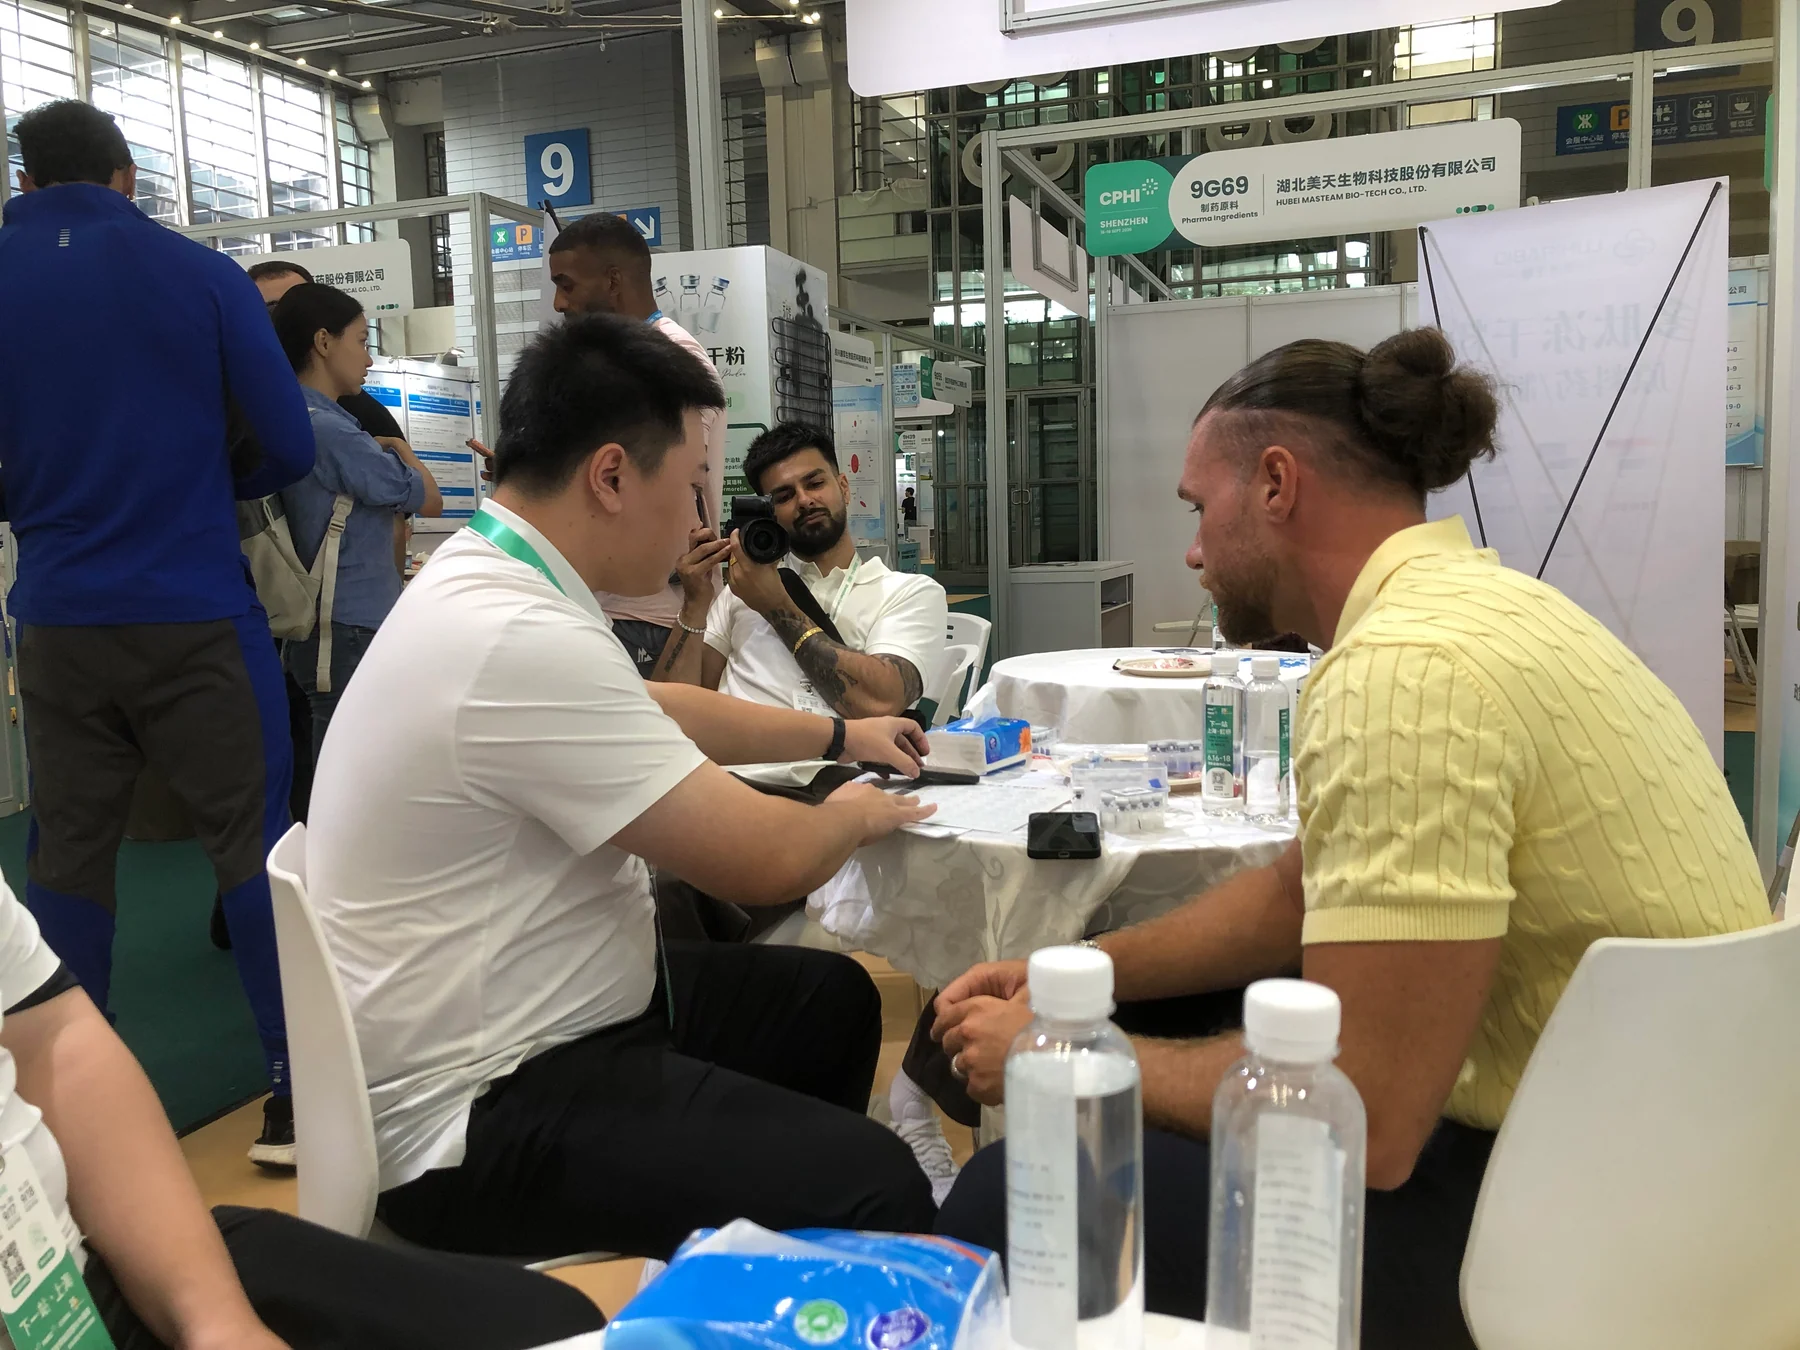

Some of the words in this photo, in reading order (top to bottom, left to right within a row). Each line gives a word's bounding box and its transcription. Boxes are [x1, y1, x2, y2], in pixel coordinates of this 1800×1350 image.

[1660, 0, 1714, 45] 9
[540, 142, 575, 197] 9
[1276, 156, 1496, 194] 湖北美天生物科技股份有限公司
[1190, 175, 1249, 199] 9G69
[1276, 197, 1301, 206] HUBEI
[1301, 193, 1344, 204] MASTEAM
[1345, 189, 1387, 200] BIO-TECH
[1388, 187, 1407, 196] CO.,
[1408, 185, 1427, 193] LTD.
[1099, 188, 1141, 206] CPHI
[1200, 200, 1239, 213] 制药原料
[1100, 216, 1149, 229] SHENZHEN
[1181, 215, 1213, 224] Pharma
[1213, 211, 1259, 222] Ingredients
[312, 268, 385, 286] 药股份有限公司
[1728, 285, 1747, 295] 公司
